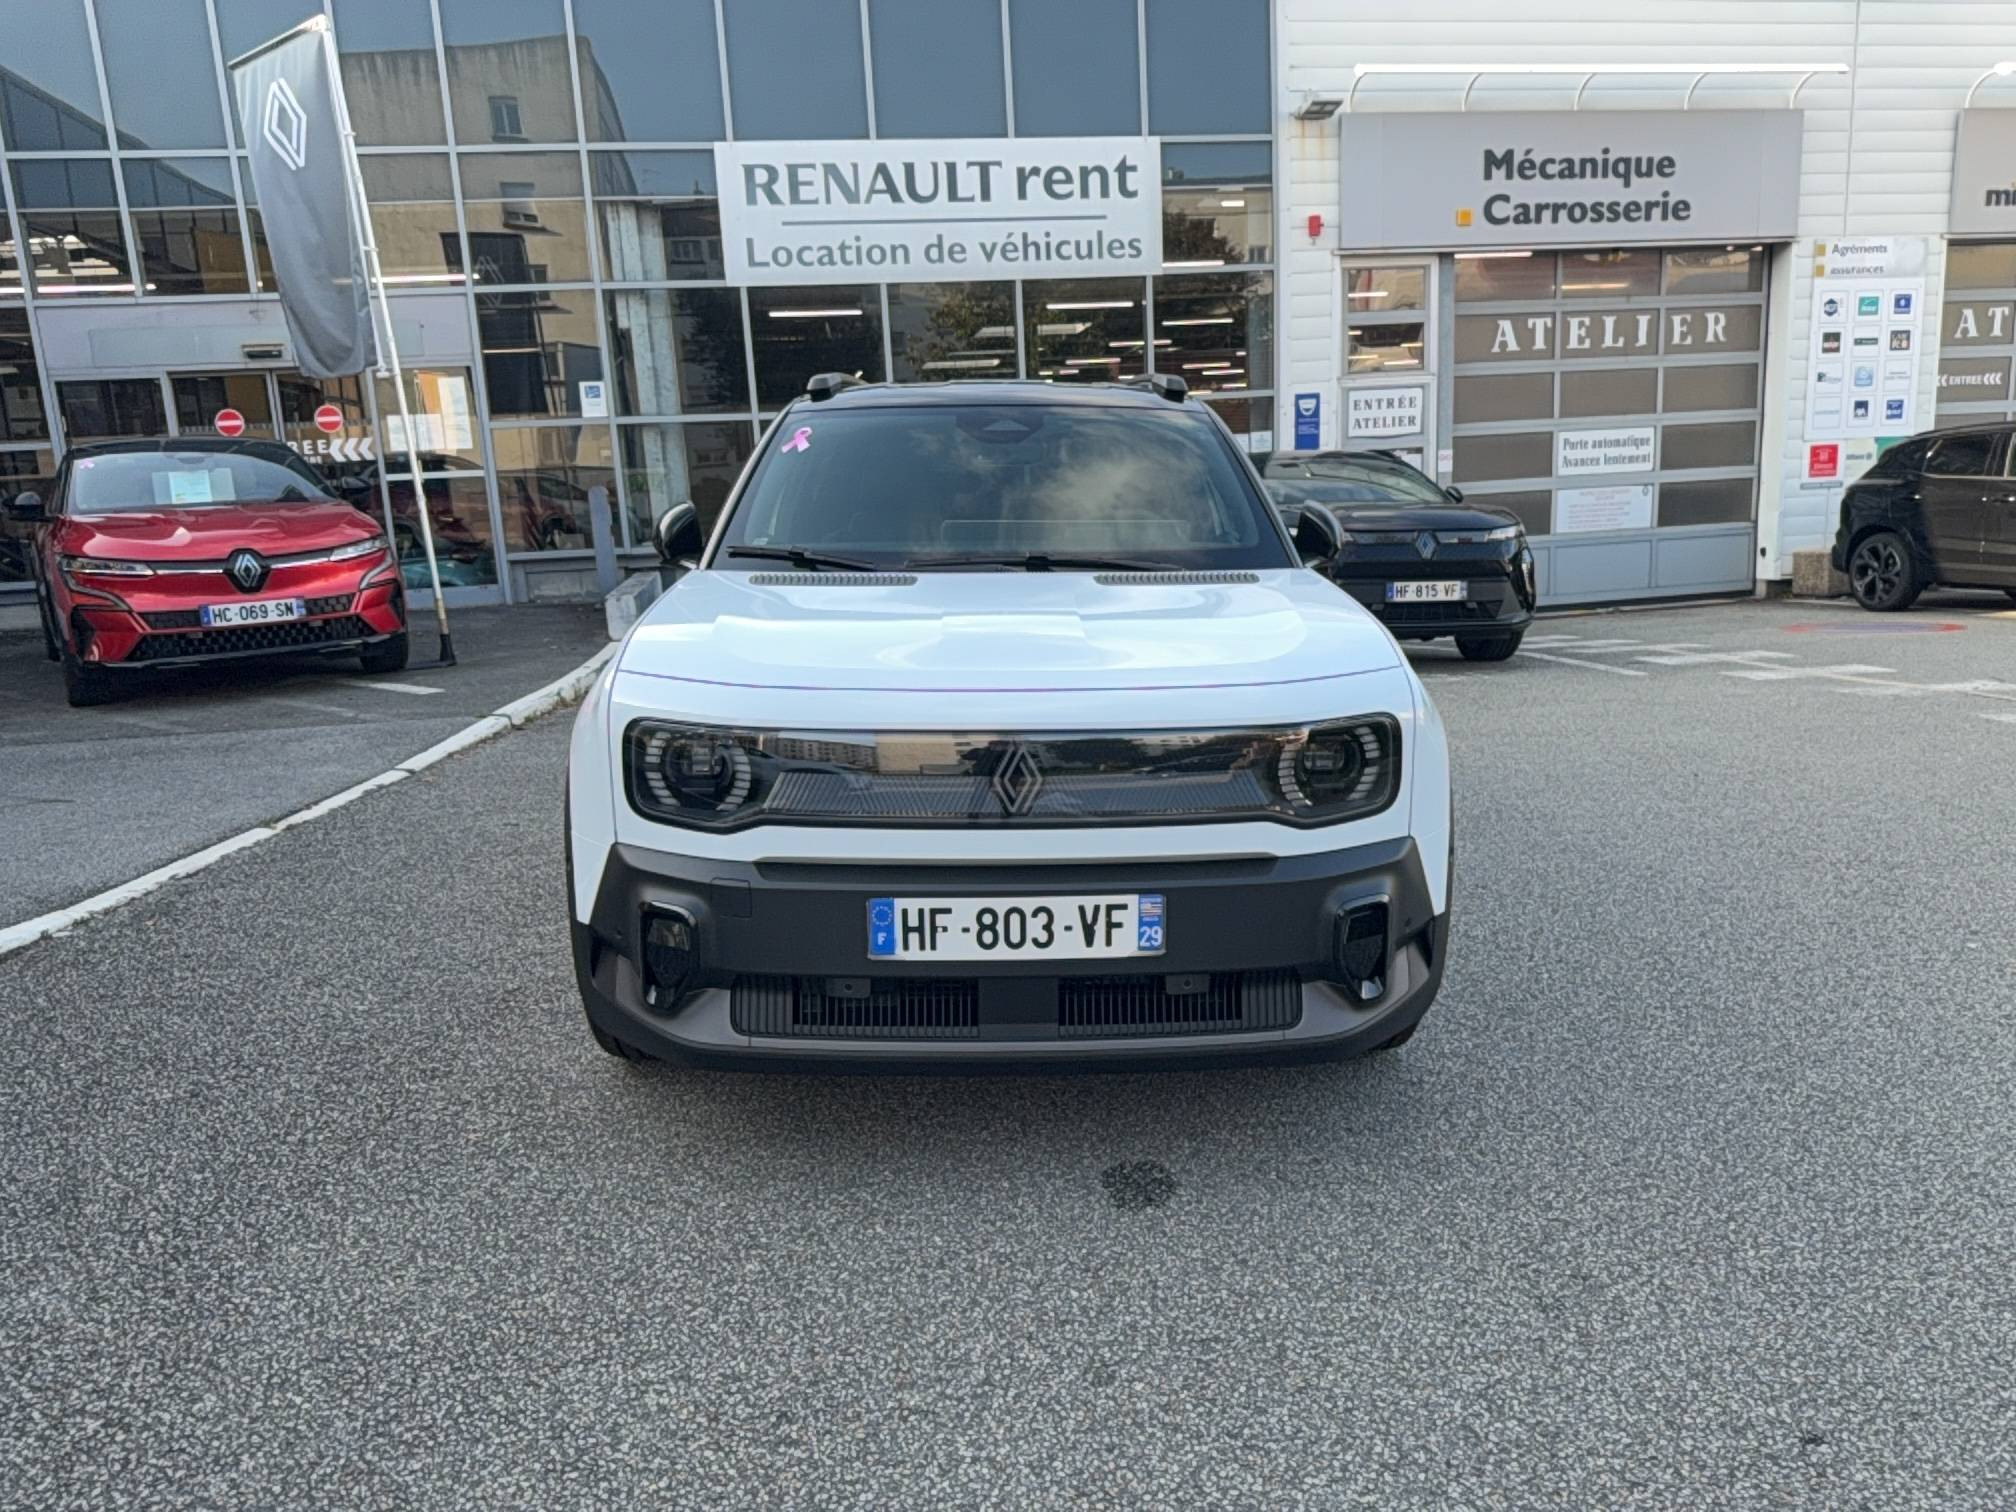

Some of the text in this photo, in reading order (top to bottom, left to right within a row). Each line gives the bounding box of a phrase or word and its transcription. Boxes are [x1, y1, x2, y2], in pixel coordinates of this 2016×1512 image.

[1483, 147, 1676, 188] Mécanique
[742, 155, 1138, 206] RENAULT rent
[1483, 190, 1691, 226] Carrosserie
[745, 230, 1142, 268] Location de véhicules
[1832, 243, 1888, 257] Agréments
[1491, 312, 1727, 352] ATELIER
[1353, 394, 1417, 411] ENTRÉE
[1352, 415, 1417, 430] ATELIER
[1563, 434, 1650, 450] Porte automatique
[1562, 453, 1651, 468] Avancez lentement
[212, 602, 294, 623] HC-069-SN
[901, 903, 1128, 951] HF-803-VF
[1139, 925, 1163, 947] 29
[877, 932, 887, 945] F
